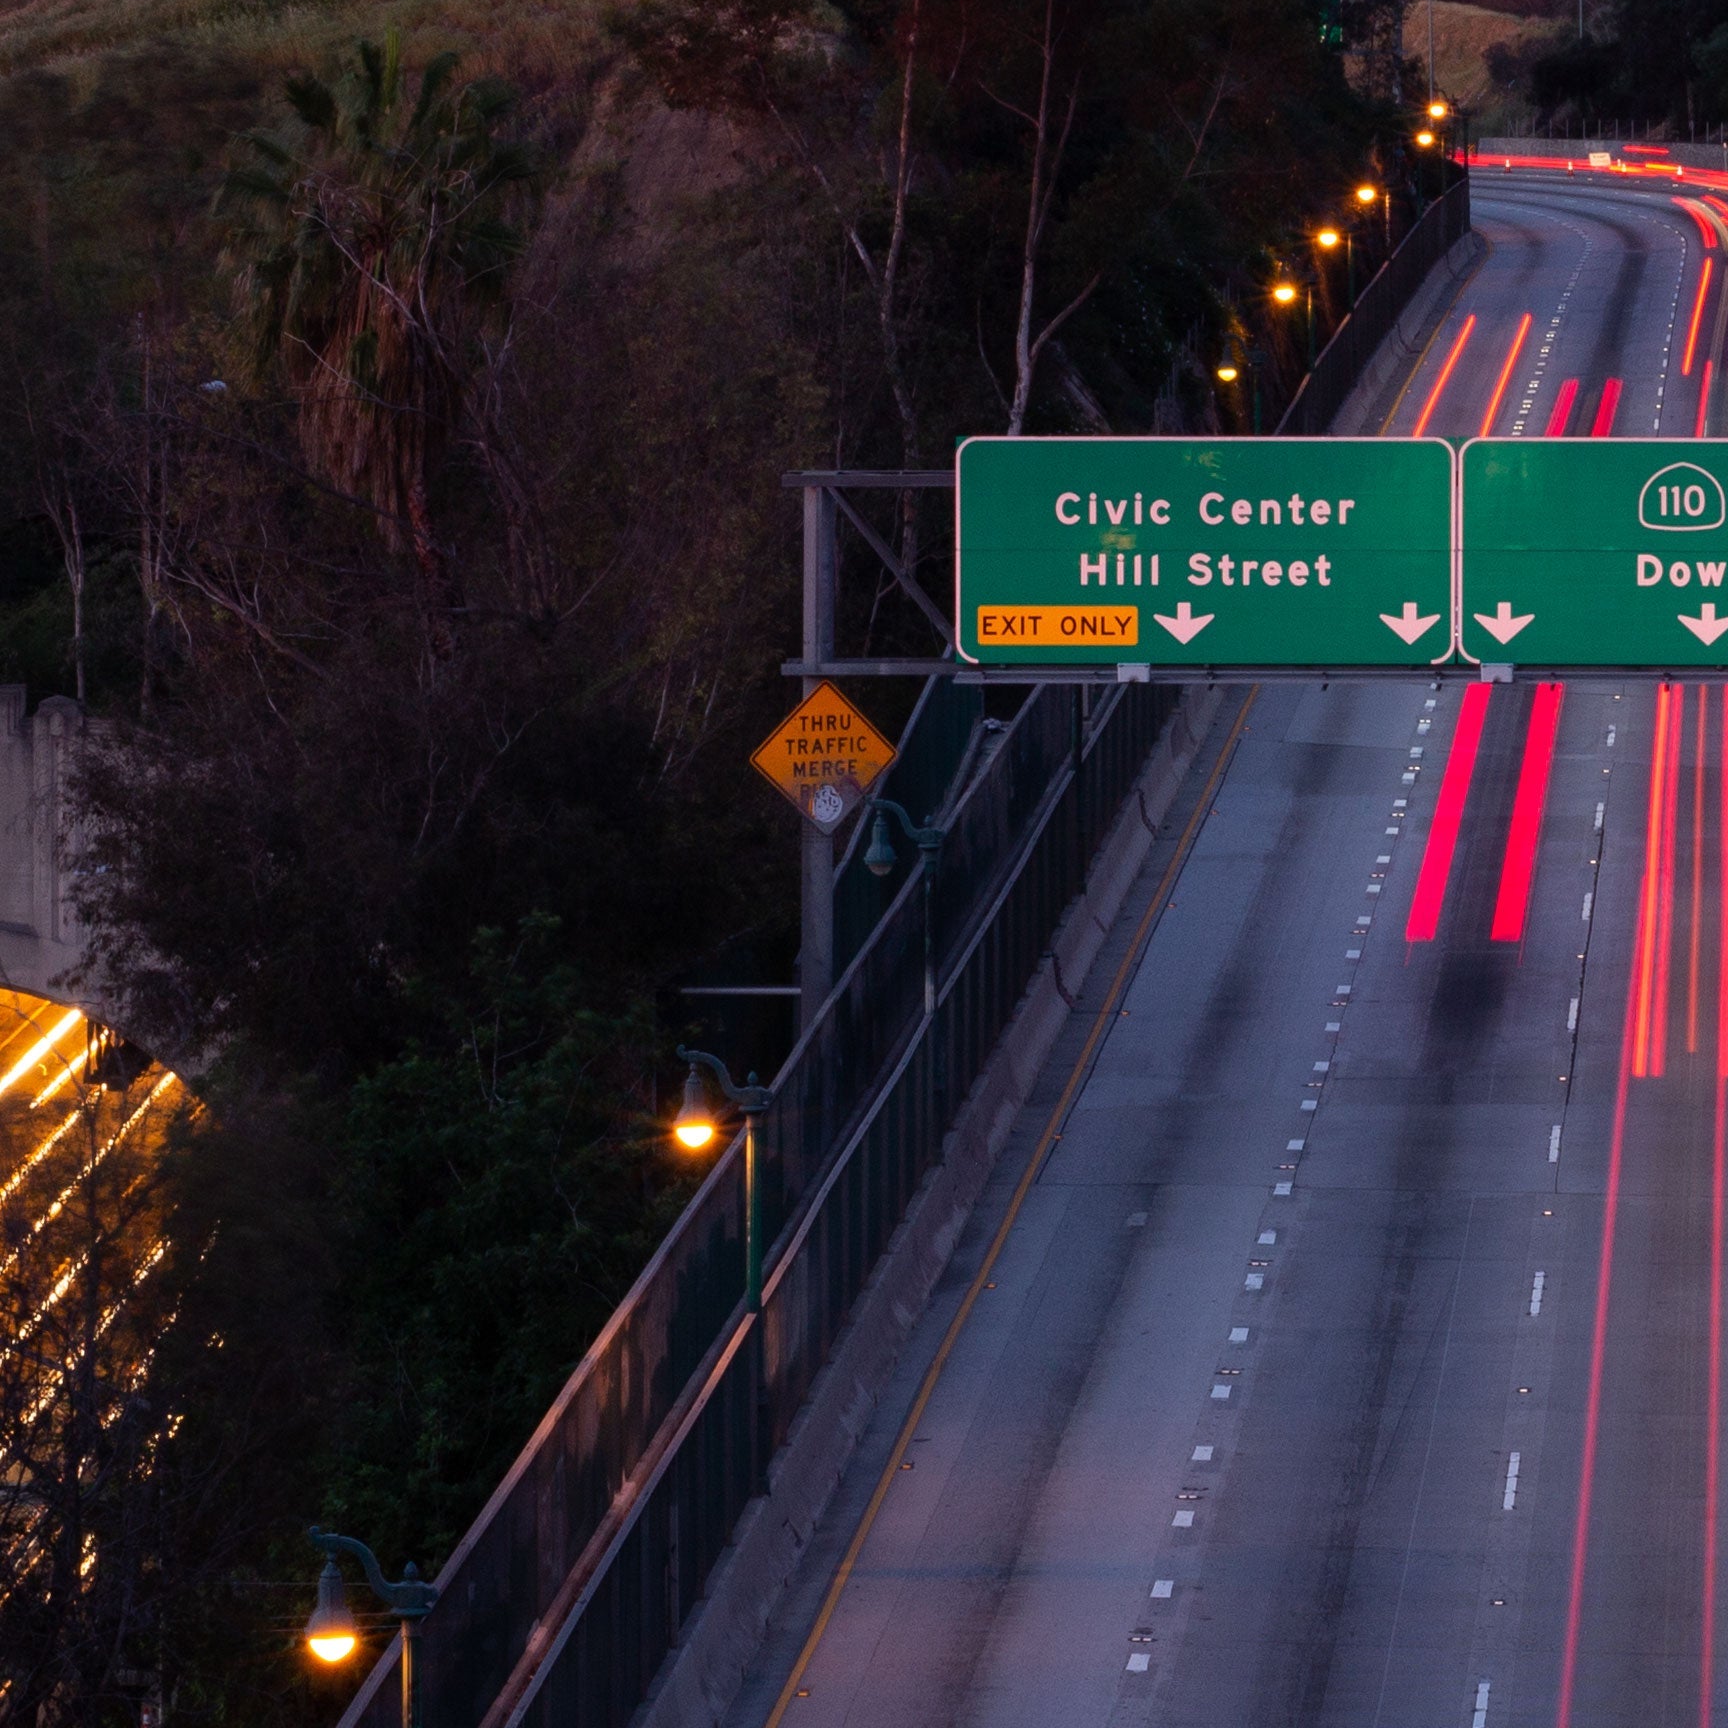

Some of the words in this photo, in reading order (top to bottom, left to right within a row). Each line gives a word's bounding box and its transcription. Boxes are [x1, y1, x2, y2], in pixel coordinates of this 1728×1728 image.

[1055, 492, 1171, 525] Civic
[1199, 492, 1355, 525] Center
[1657, 485, 1706, 517] 110
[1080, 553, 1159, 586] Hill
[1187, 553, 1331, 586] Street
[982, 615, 1042, 636] EXIT
[1060, 615, 1132, 636] ONLY
[799, 714, 851, 732] THRU
[785, 735, 867, 755] TRAFFIC
[793, 759, 858, 778] MERGE
